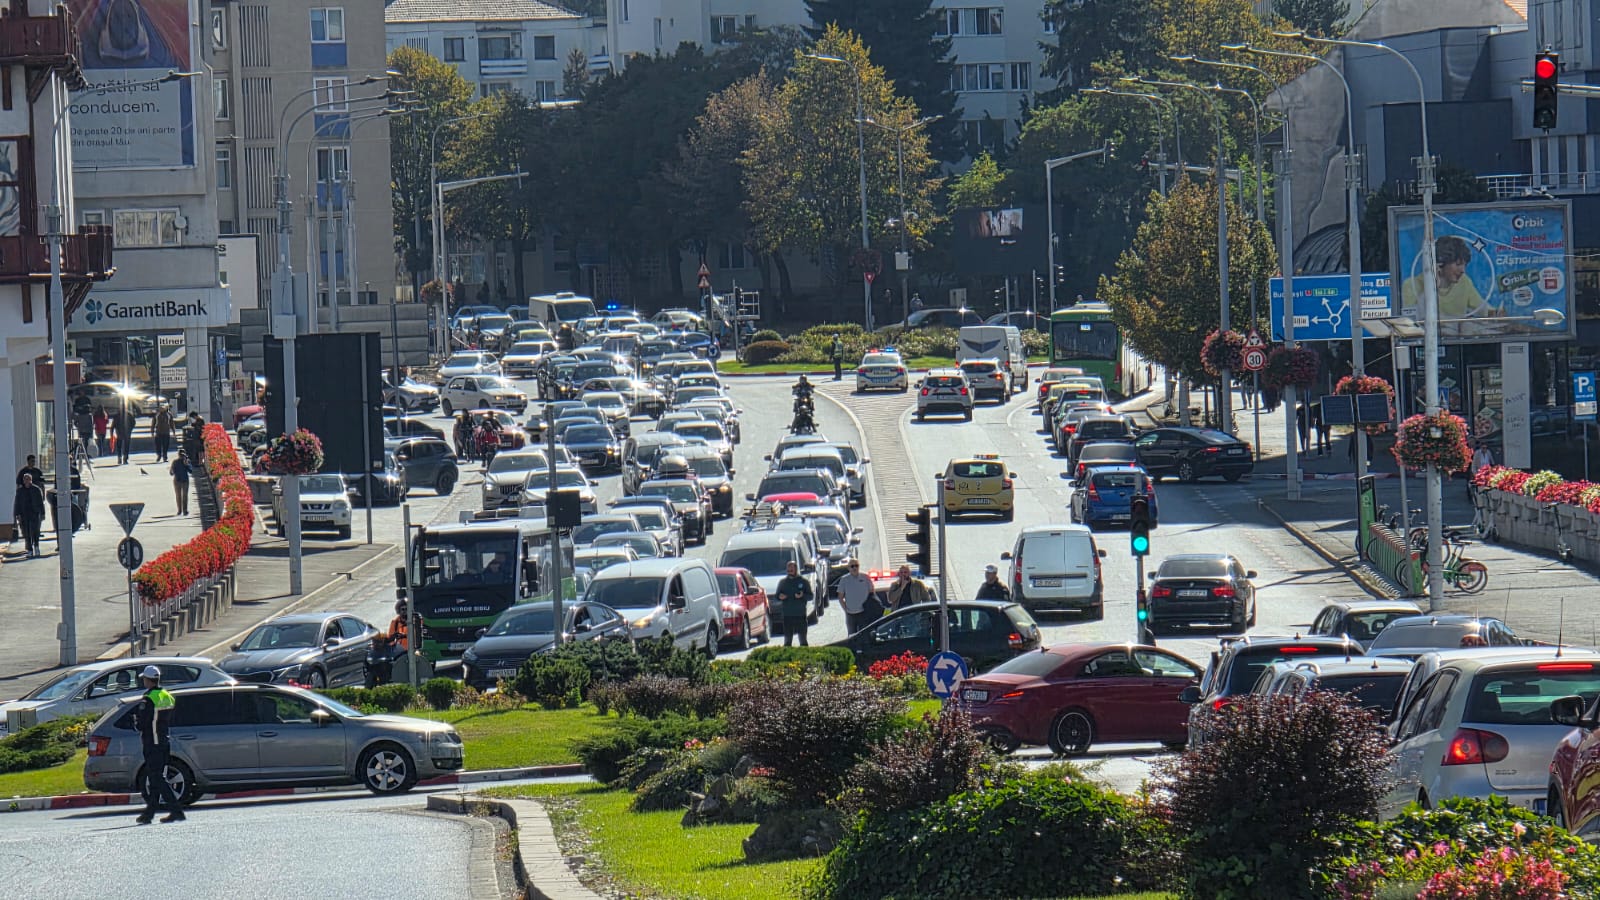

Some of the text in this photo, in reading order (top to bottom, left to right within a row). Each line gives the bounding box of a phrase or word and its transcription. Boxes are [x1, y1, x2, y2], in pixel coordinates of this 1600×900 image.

[70, 100, 160, 115] conducem.
[111, 126, 122, 135] 20
[152, 126, 176, 135] parte
[1512, 215, 1545, 231] Orbit
[105, 299, 208, 319] GarantiBank
[1249, 355, 1261, 365] 30
[1578, 376, 1590, 393] P
